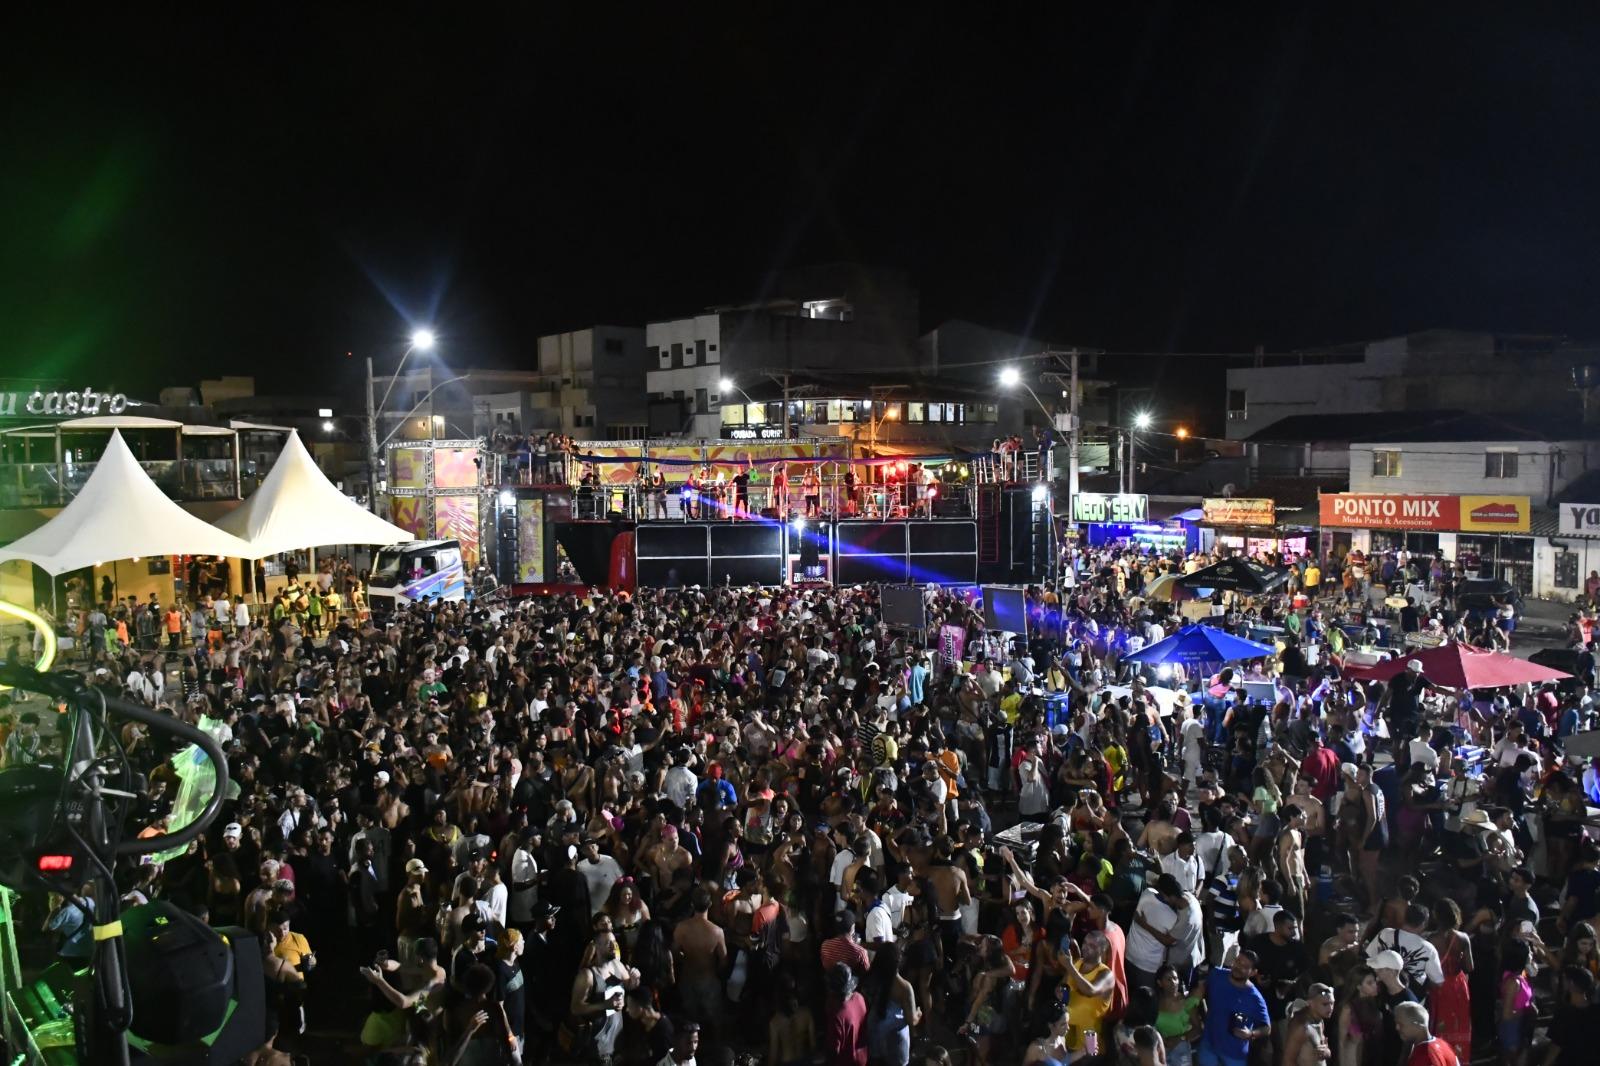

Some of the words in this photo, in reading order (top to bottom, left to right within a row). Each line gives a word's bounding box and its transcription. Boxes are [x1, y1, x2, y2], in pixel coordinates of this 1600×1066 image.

[26, 386, 128, 415] castro
[730, 429, 757, 439] POUSADA
[1112, 496, 1146, 522] SEXY
[1334, 498, 1397, 516] PONTO
[1402, 500, 1441, 518] MIX
[1342, 515, 1363, 524] Moda
[1364, 516, 1383, 525] Praia
[1384, 517, 1392, 525] &
[1393, 518, 1433, 526] Acessórios
